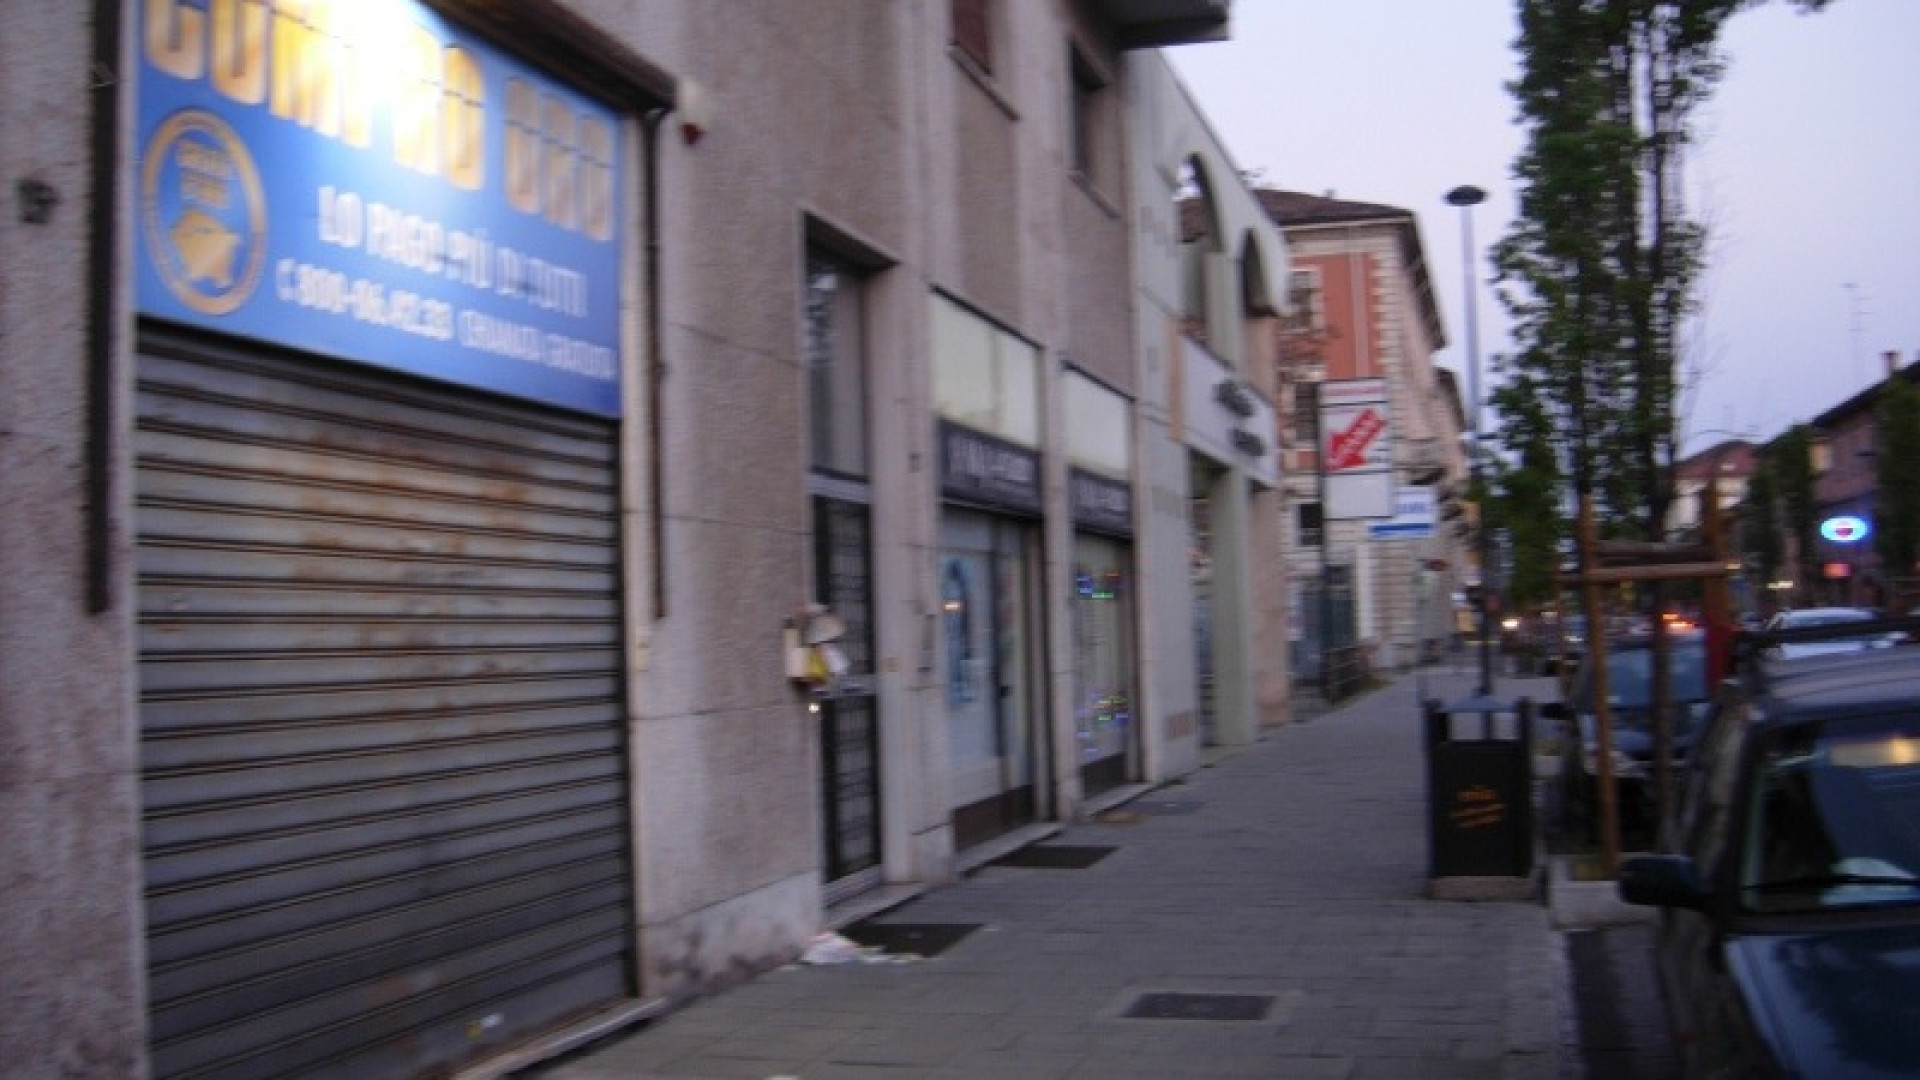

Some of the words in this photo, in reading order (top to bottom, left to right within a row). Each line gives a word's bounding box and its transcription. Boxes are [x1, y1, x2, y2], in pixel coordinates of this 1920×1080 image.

[504, 76, 614, 242] ORO
[318, 186, 363, 247] LO
[366, 203, 445, 273] PAGO
